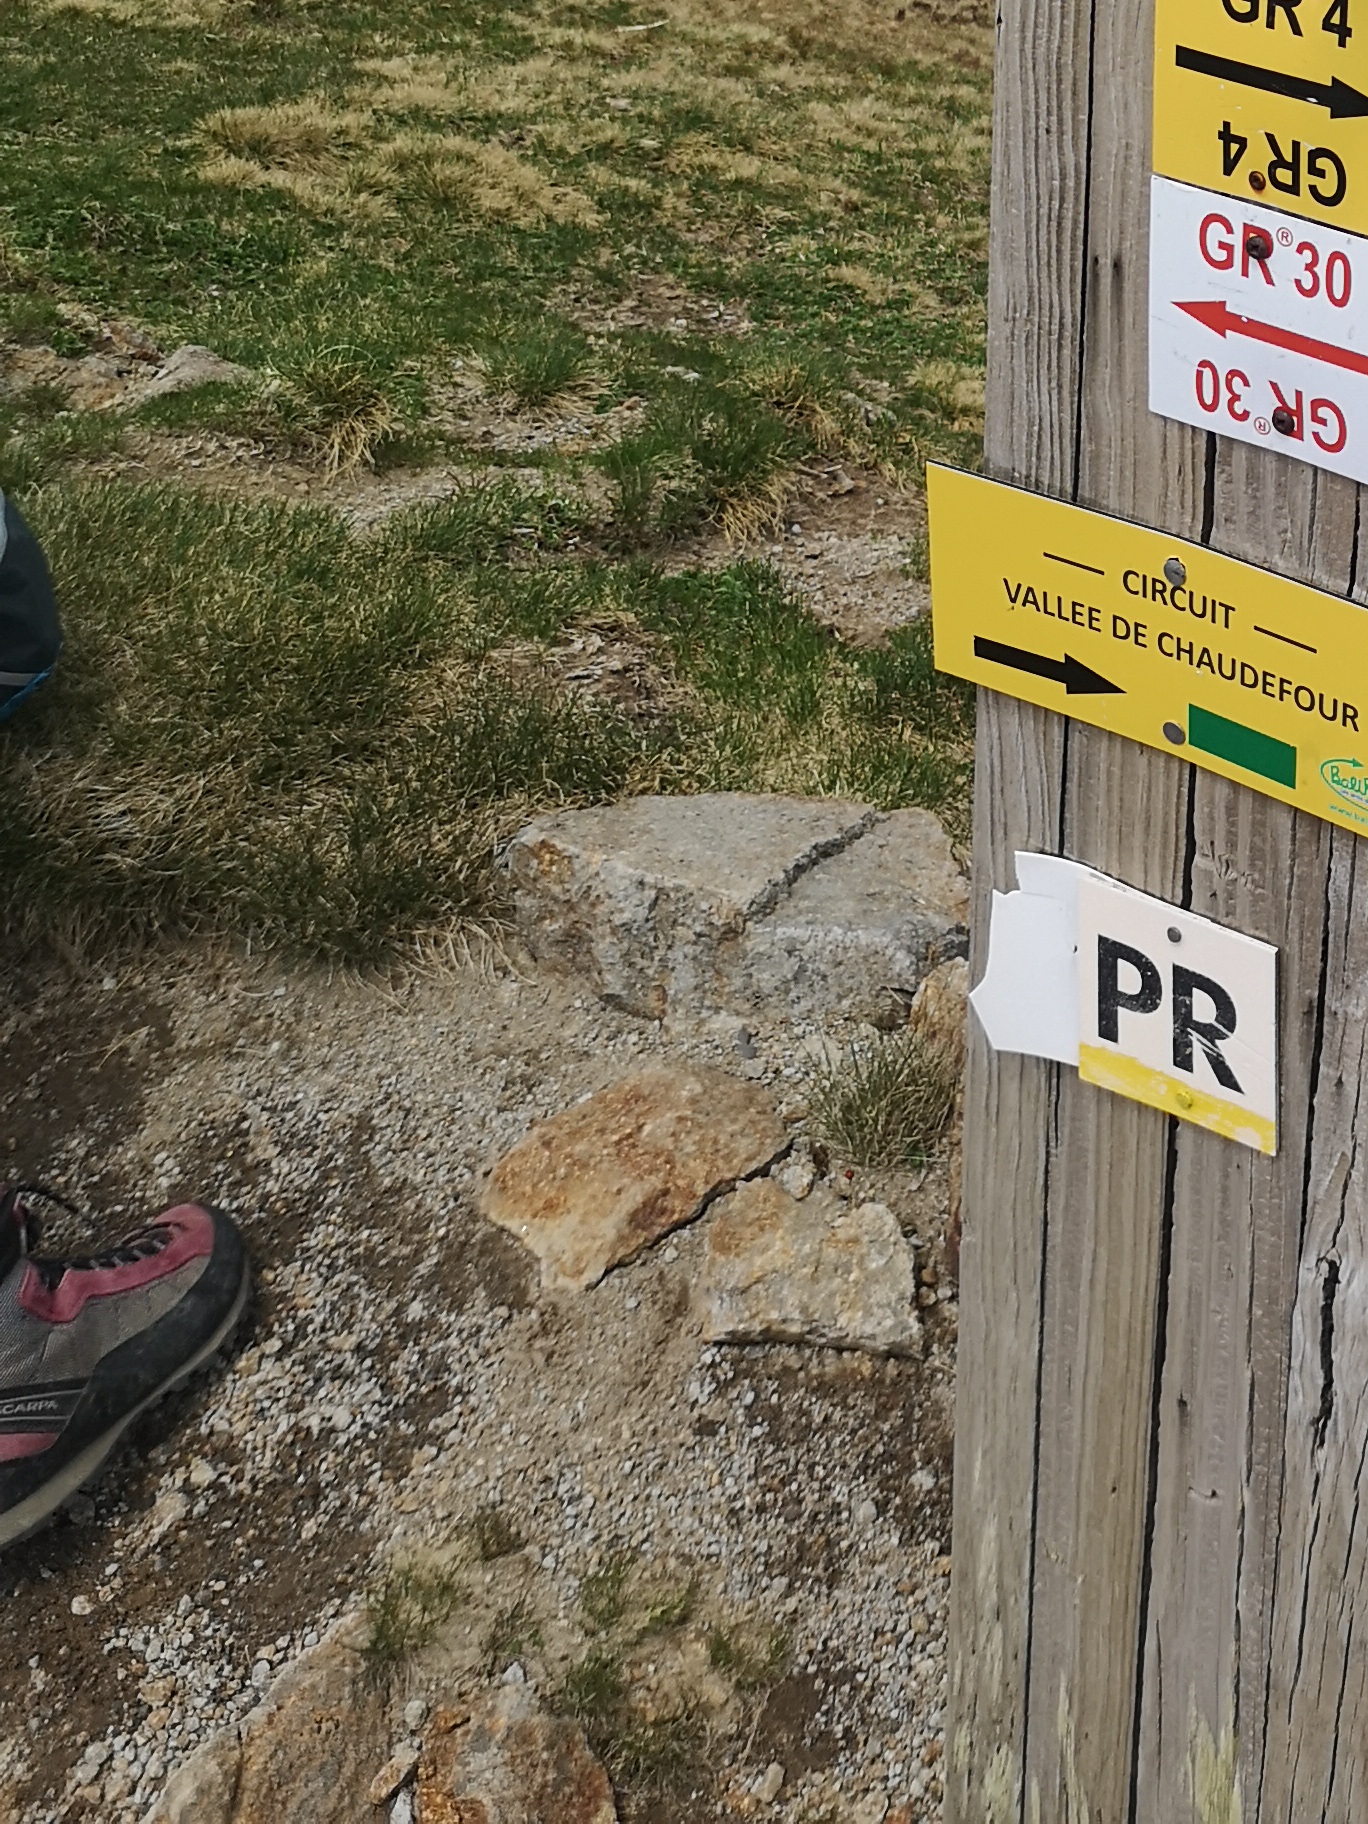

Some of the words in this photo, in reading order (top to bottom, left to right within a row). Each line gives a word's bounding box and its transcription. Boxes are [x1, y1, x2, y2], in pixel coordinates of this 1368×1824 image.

[1216, 120, 1249, 178] 4
[1264, 131, 1348, 208] GR
[1293, 244, 1353, 309] 30
[1194, 359, 1252, 423] 30
[1121, 569, 1237, 630] CIRCUIT
[1001, 576, 1102, 633] VALLEE
[1111, 614, 1149, 649] DE
[1156, 631, 1361, 733] CHAUDEFOUR
[1096, 933, 1246, 1095] PR
[0, 1399, 59, 1415] CARPA
